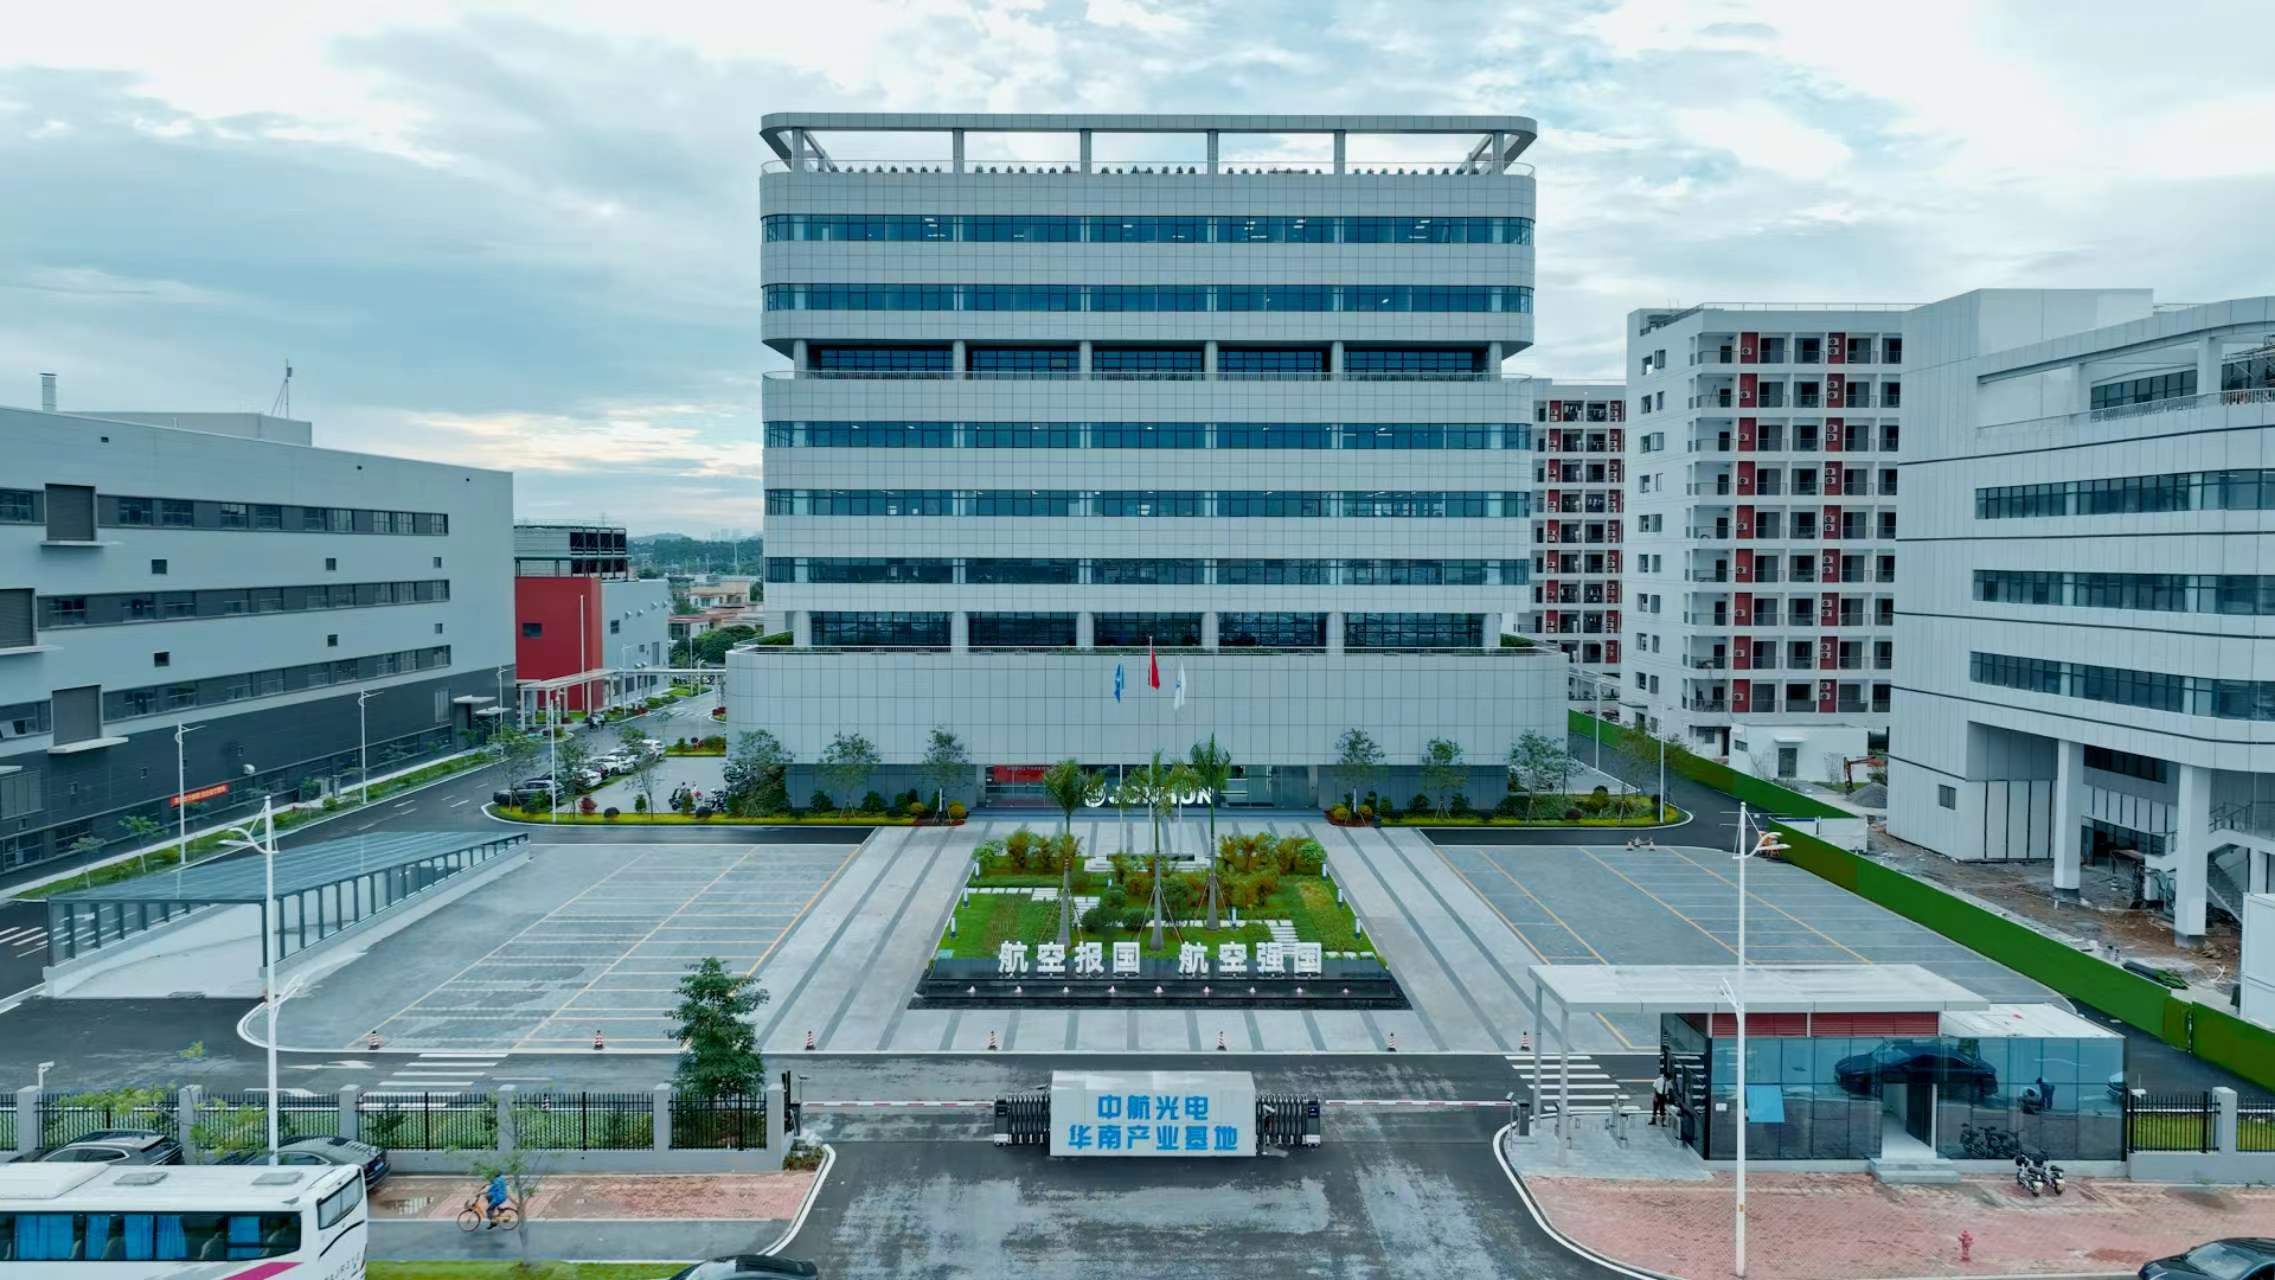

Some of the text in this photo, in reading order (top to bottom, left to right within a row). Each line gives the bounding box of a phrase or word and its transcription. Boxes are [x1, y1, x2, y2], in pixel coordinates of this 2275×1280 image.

[998, 940, 1322, 974] 航空报国 航空强国
[1097, 1095, 1209, 1121] 中航光电
[1068, 1124, 1238, 1151] 华南产业基地
